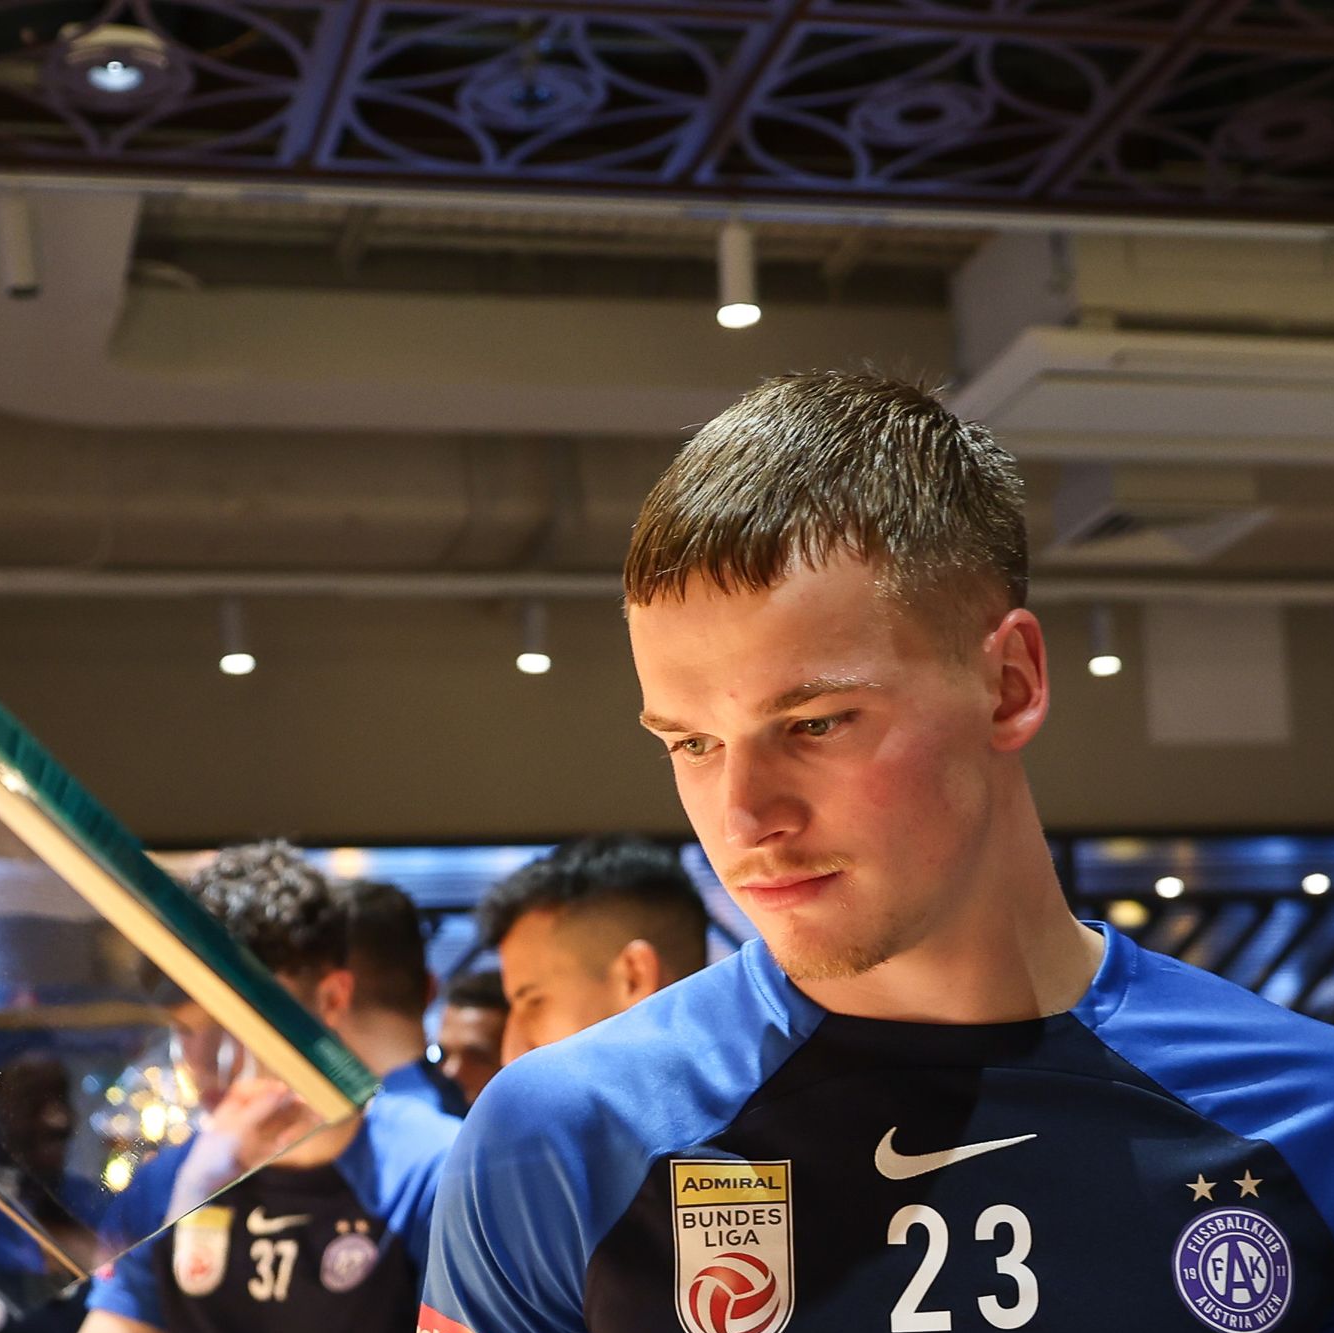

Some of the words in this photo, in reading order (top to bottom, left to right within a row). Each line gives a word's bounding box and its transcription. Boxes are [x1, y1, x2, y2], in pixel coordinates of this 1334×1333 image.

[681, 1176, 782, 1193] ADMIRAL
[682, 1208, 782, 1229] BUNDES
[704, 1229, 760, 1248] LIGA
[1187, 1216, 1282, 1254] FUSSBALLKLUB
[247, 1238, 299, 1302] 37
[887, 1203, 1040, 1333] 23
[1183, 1267, 1198, 1280] 19
[1276, 1265, 1287, 1278] 11
[1195, 1295, 1254, 1329] AUSTRIA
[1254, 1293, 1283, 1325] WIEN
